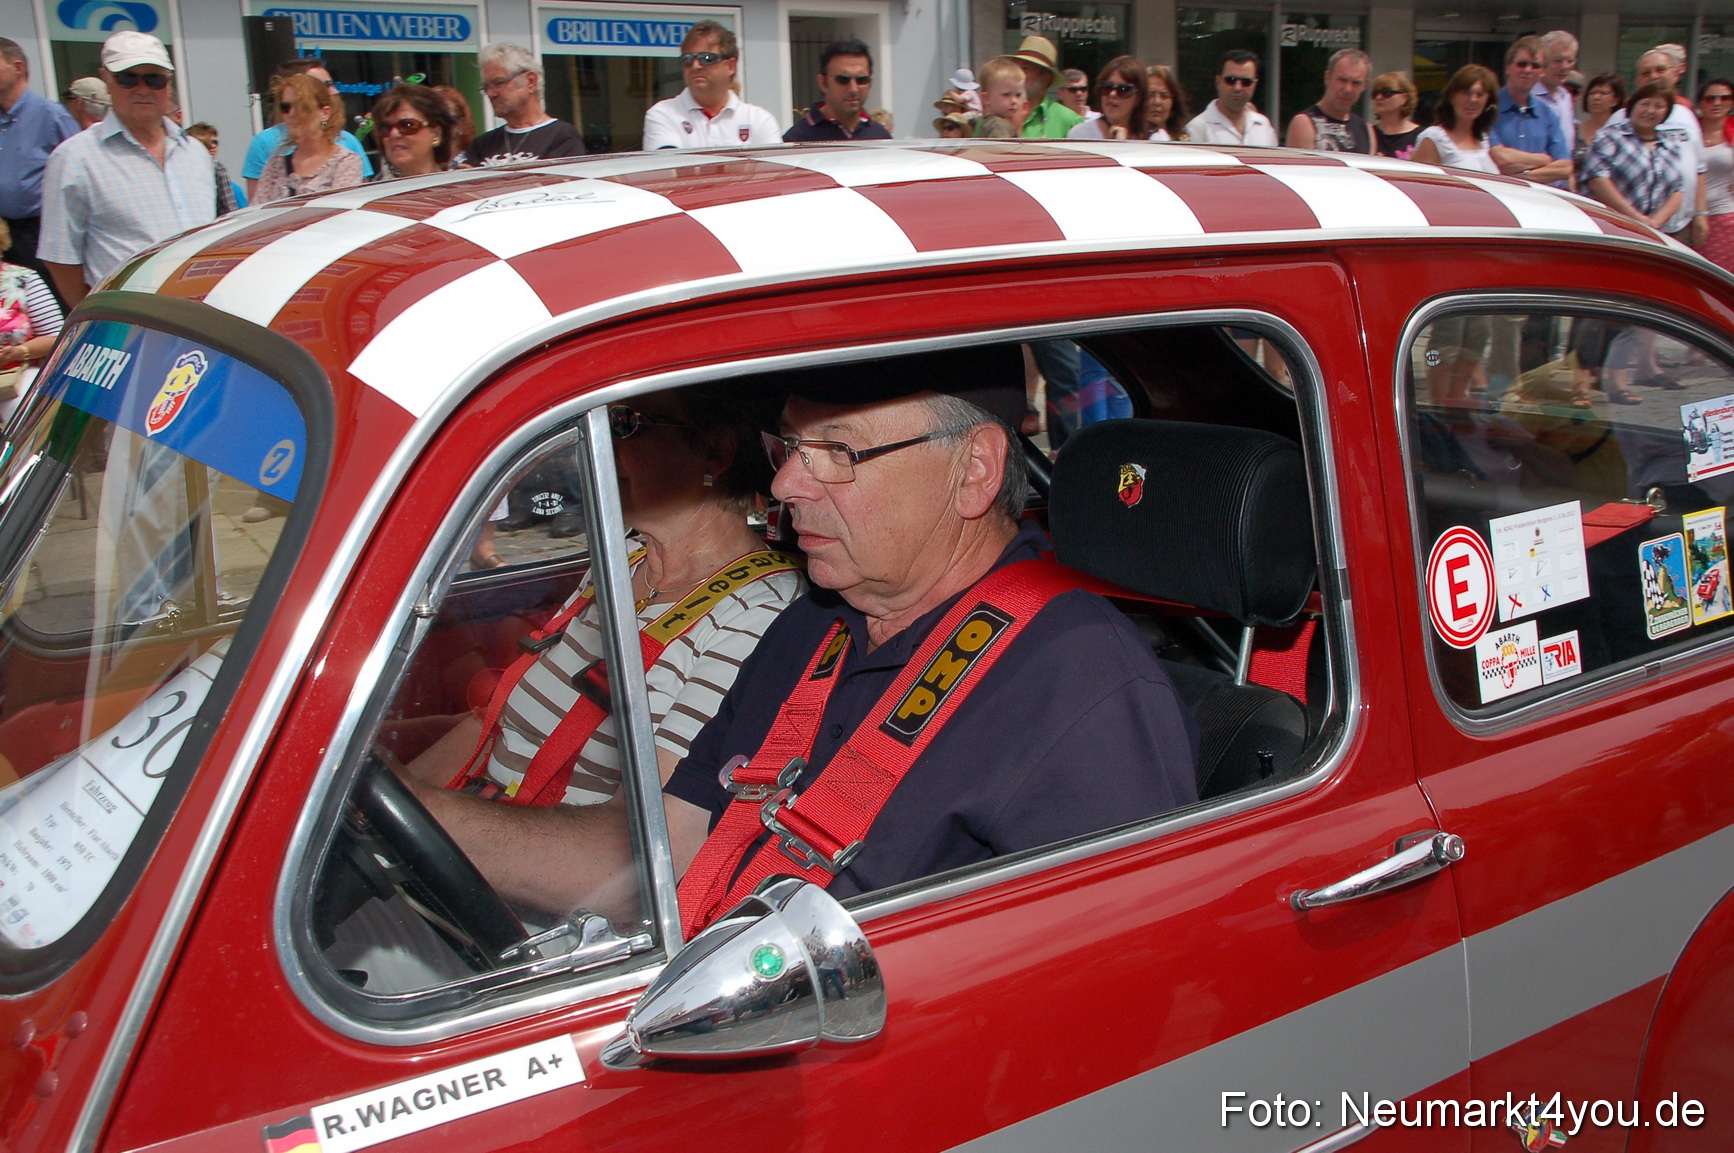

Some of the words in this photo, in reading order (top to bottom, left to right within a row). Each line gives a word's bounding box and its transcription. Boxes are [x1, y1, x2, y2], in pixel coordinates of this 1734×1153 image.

[272, 11, 371, 37] RILLEN
[376, 14, 464, 40] WEBER
[557, 20, 641, 44] BRILLEN
[1042, 12, 1117, 38] Rupprecht
[1298, 25, 1361, 47] Rupprecht
[63, 343, 132, 390] ABARTH
[1446, 554, 1477, 622] E
[1495, 633, 1520, 650] ABARTH
[897, 620, 993, 720] OMP
[1481, 656, 1500, 670] COPPA
[1520, 645, 1536, 658] MILLE
[84, 779, 118, 813] Fahrzeug
[59, 800, 88, 830] Hersteller:
[87, 828, 102, 844] Fiat
[322, 1067, 507, 1139] R.WAGNER
[527, 1053, 563, 1080] A+
